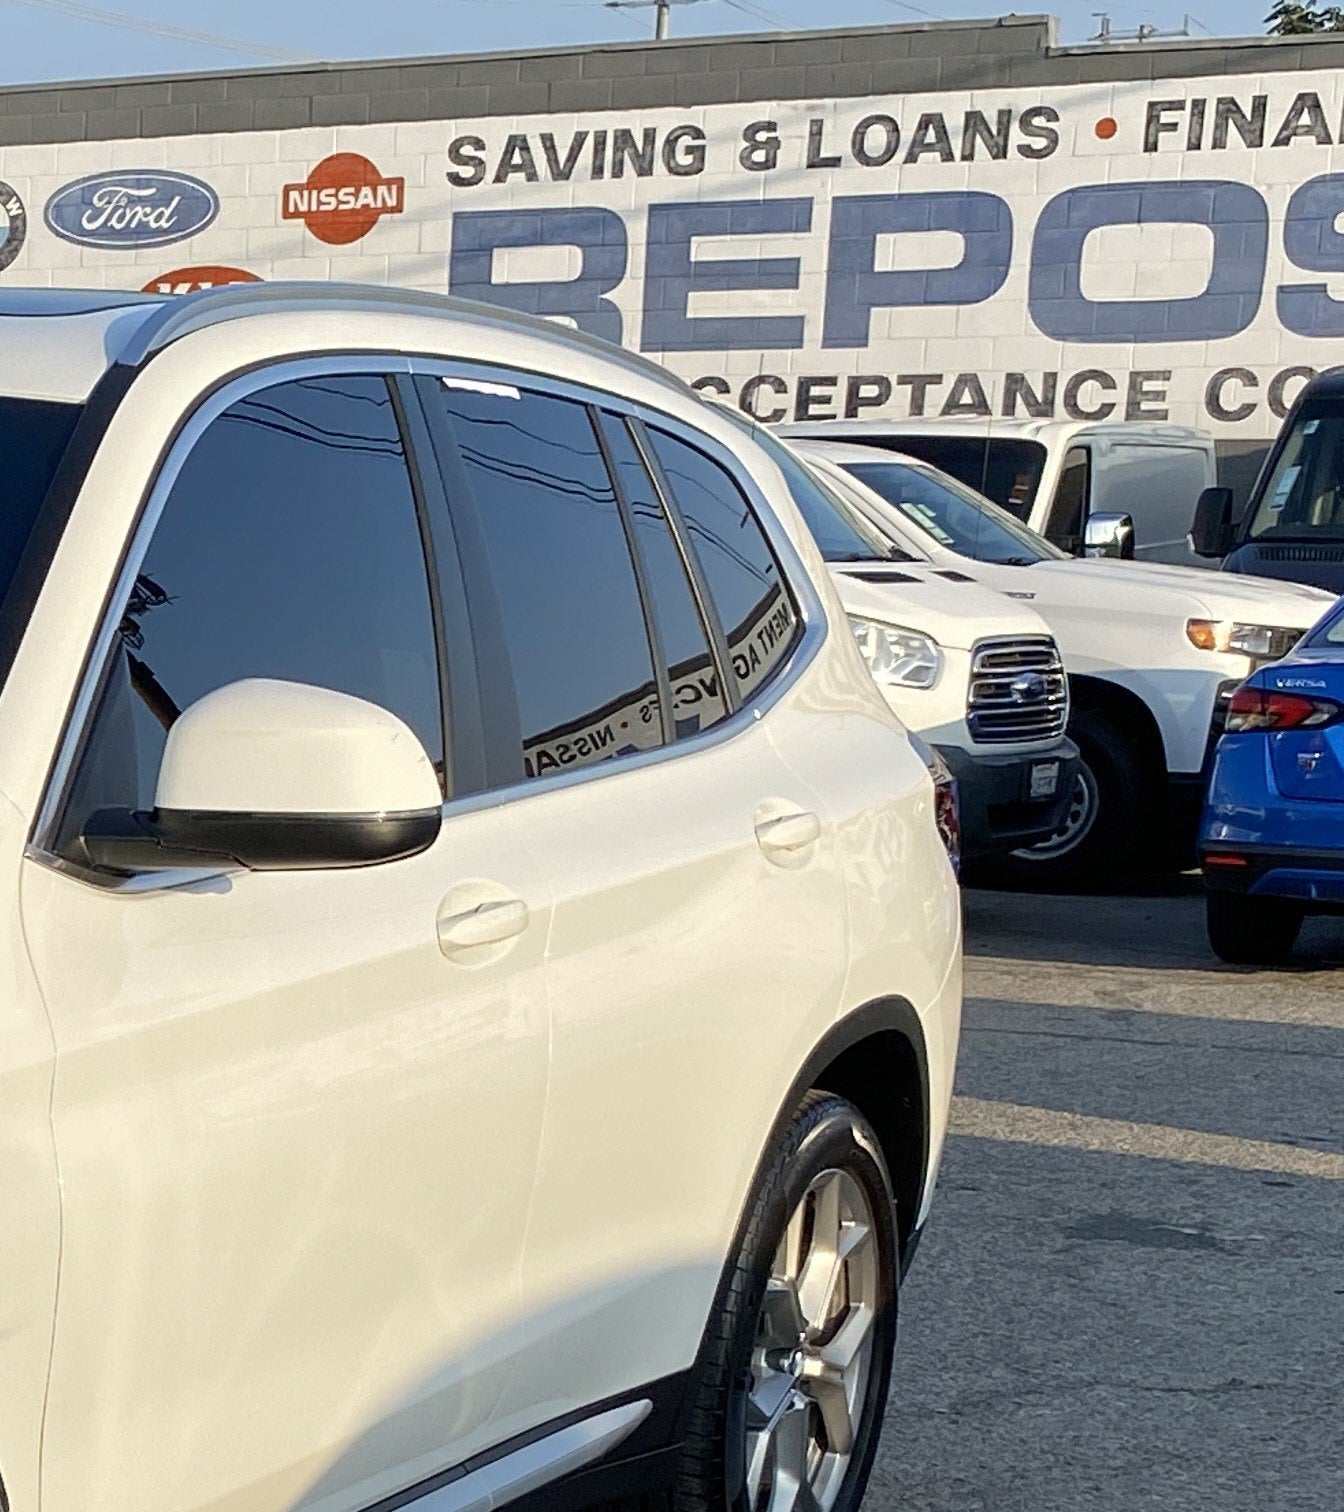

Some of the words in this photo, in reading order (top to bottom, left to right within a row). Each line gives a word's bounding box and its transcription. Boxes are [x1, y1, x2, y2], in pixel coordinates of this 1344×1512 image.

[445, 124, 707, 188] SAVING
[738, 120, 782, 172] &
[805, 105, 1061, 169] LOANS
[1142, 91, 1344, 154] FINA
[81, 186, 179, 231] Ford
[288, 184, 398, 213] NISSAN
